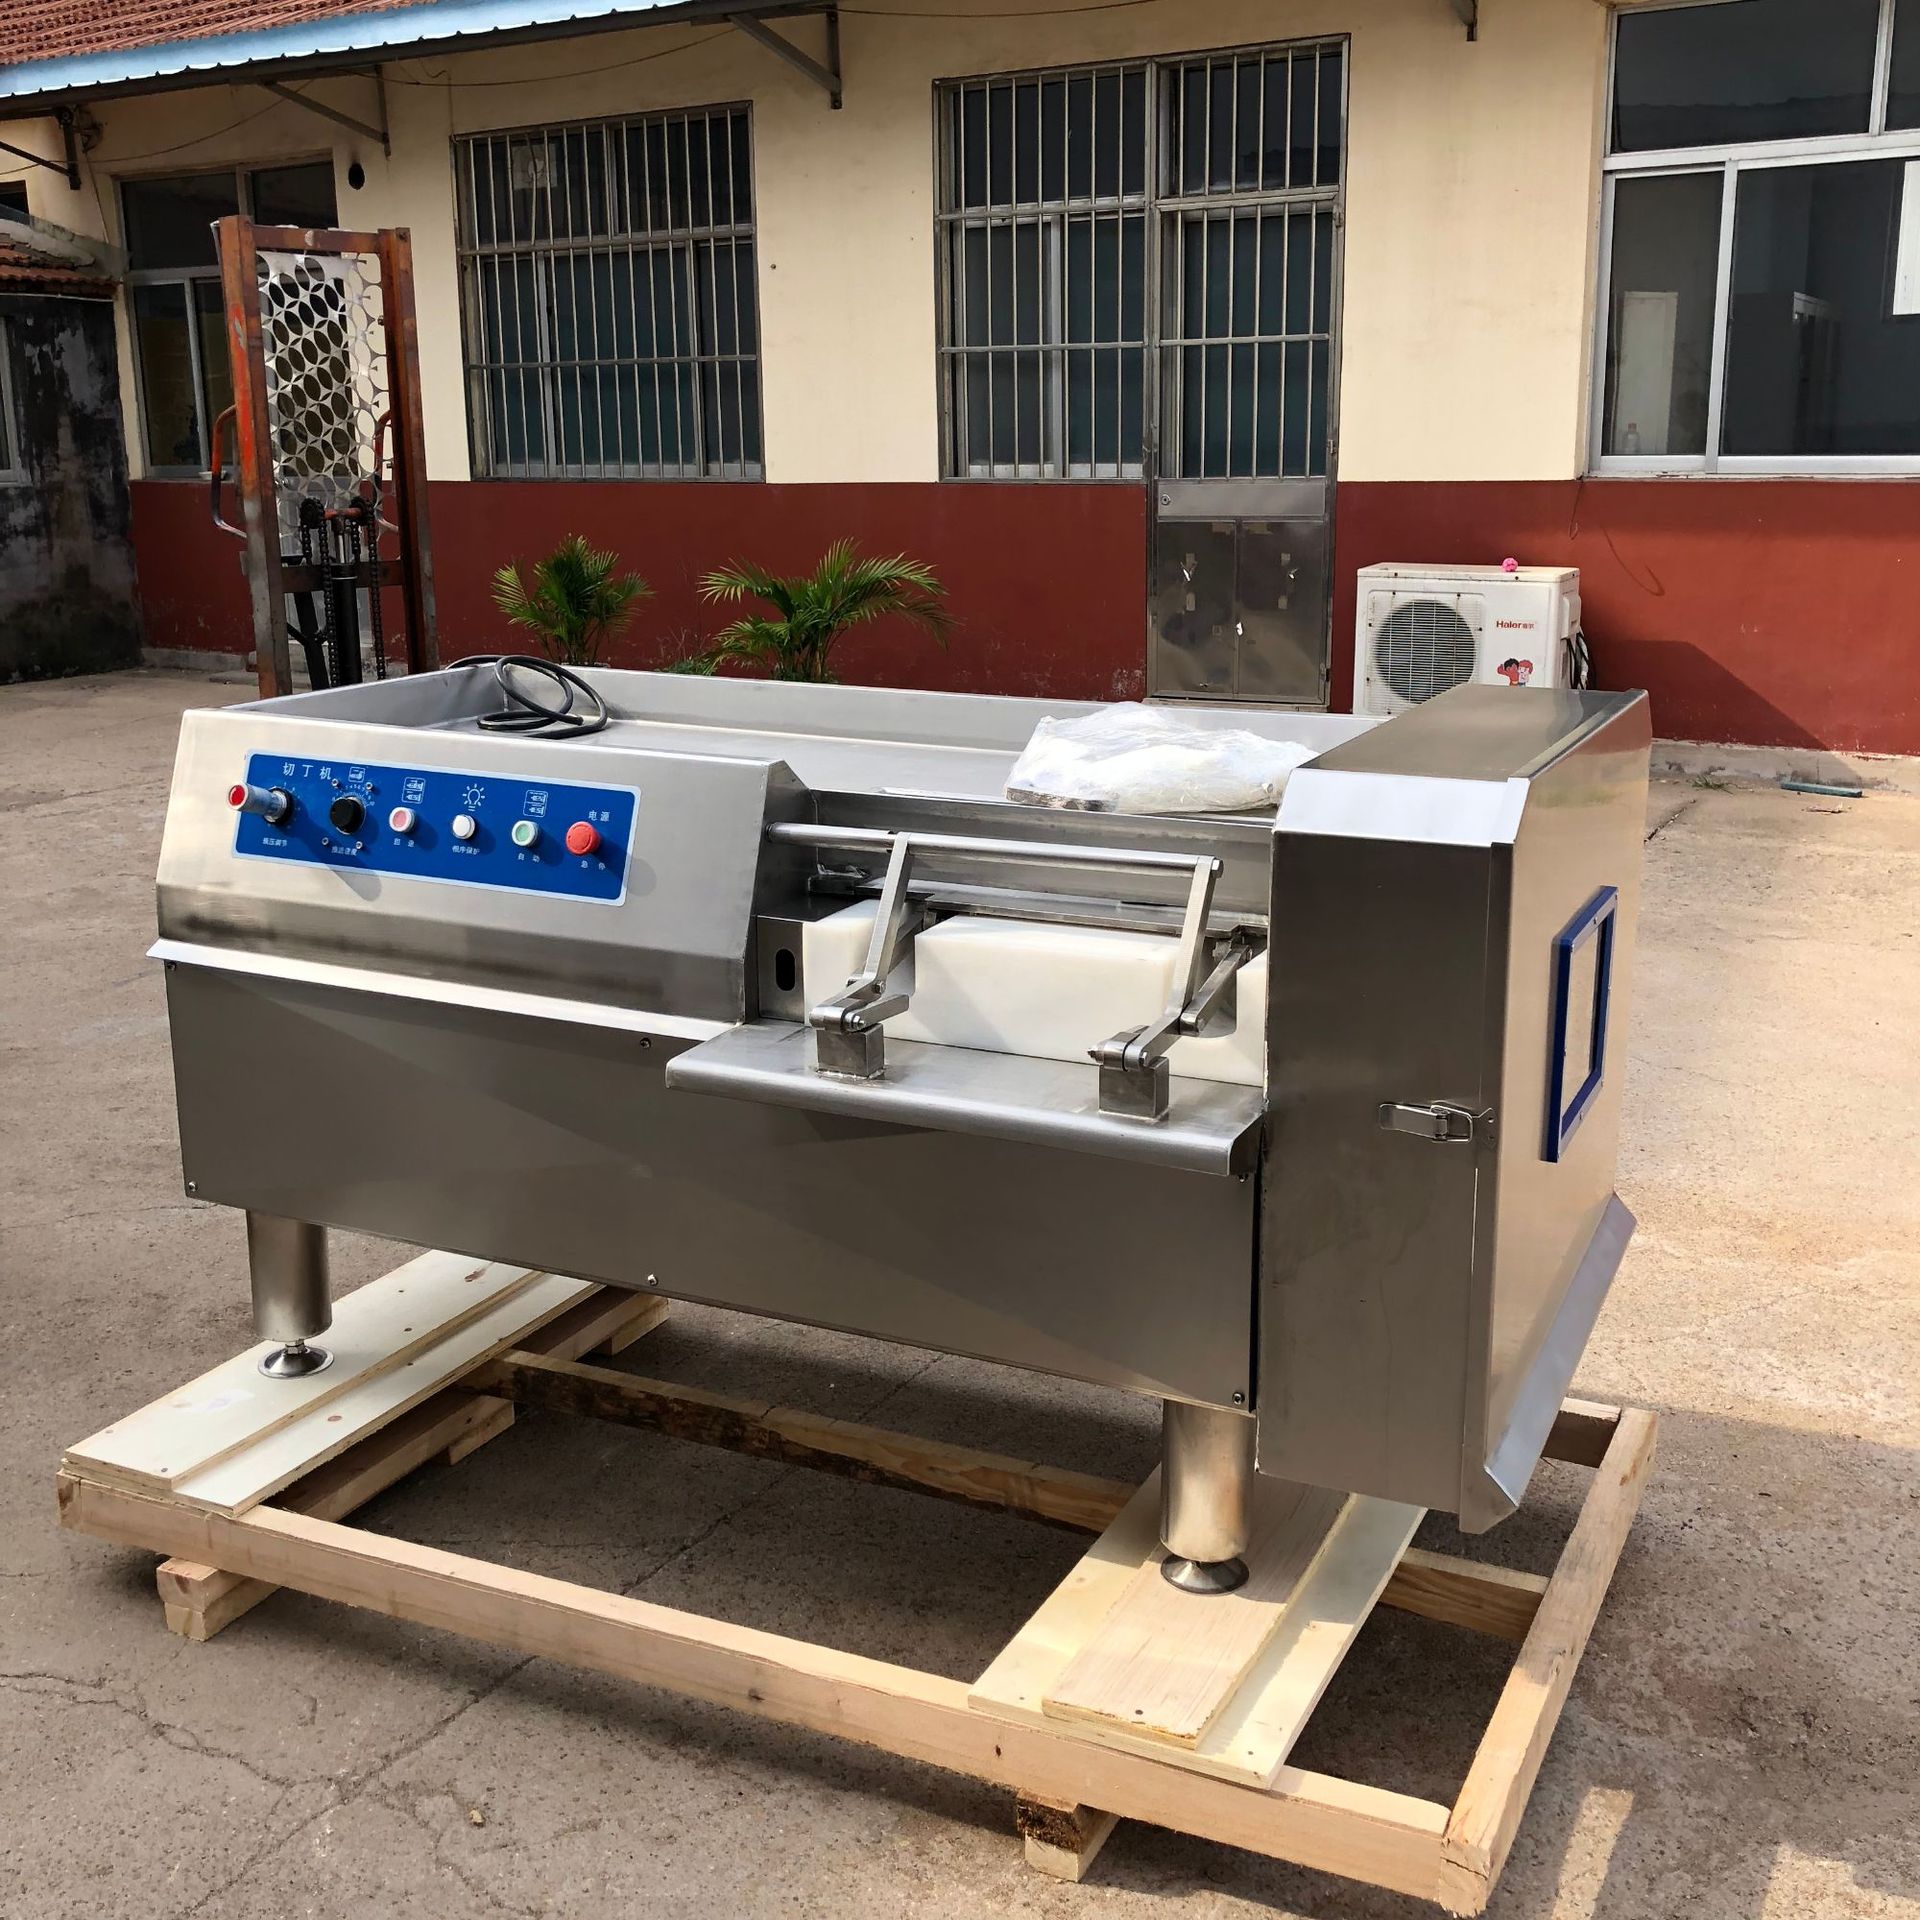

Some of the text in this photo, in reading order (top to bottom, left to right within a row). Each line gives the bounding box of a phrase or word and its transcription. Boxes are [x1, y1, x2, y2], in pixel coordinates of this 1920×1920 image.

[282, 762, 332, 780] 切丁机
[588, 810, 610, 822] 电源
